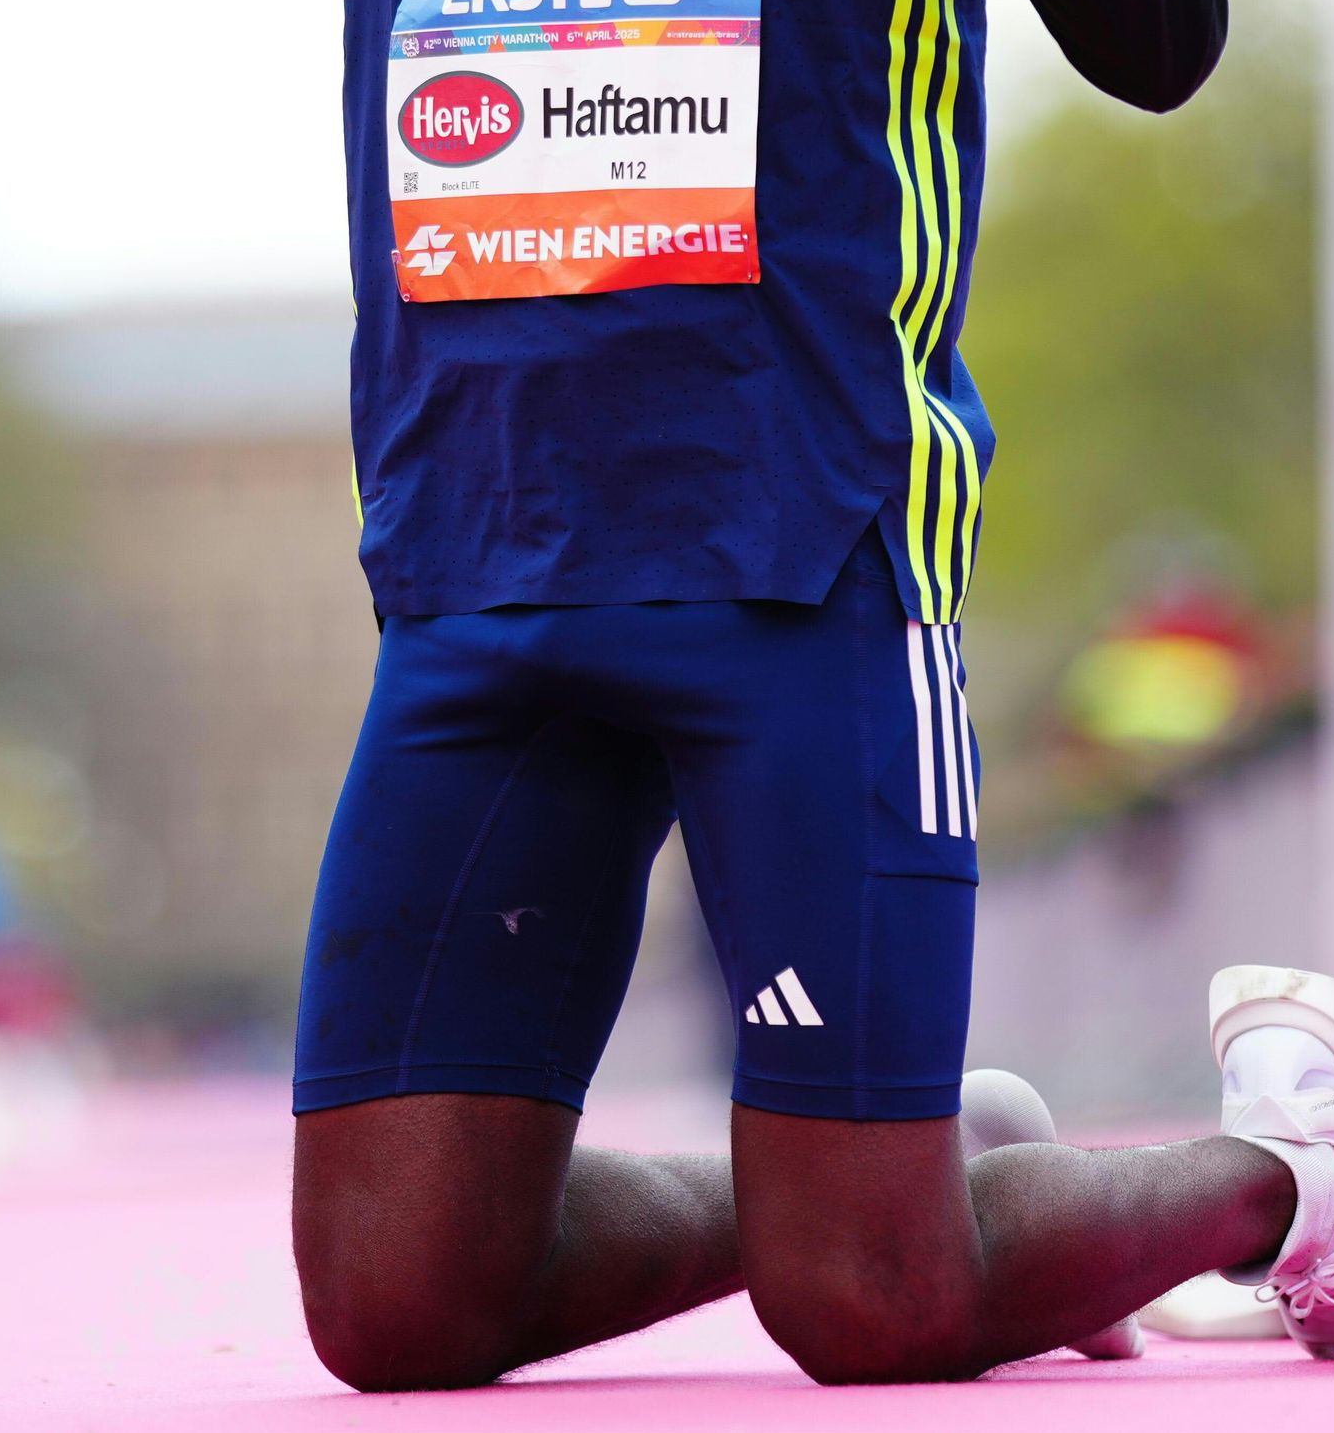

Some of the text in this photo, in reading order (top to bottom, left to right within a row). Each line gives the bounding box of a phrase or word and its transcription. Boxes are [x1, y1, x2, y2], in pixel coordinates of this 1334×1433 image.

[443, 36, 476, 48] VIENNA
[478, 34, 500, 46] CITY
[501, 31, 559, 44] MARATHON
[585, 30, 612, 41] APRIL
[615, 28, 641, 39] 2025
[412, 95, 512, 145] Hervis
[543, 83, 728, 139] Haftamu
[611, 161, 647, 180] M12
[442, 180, 480, 192] Block ELITE
[467, 224, 744, 264] WIEN ENERGIE
